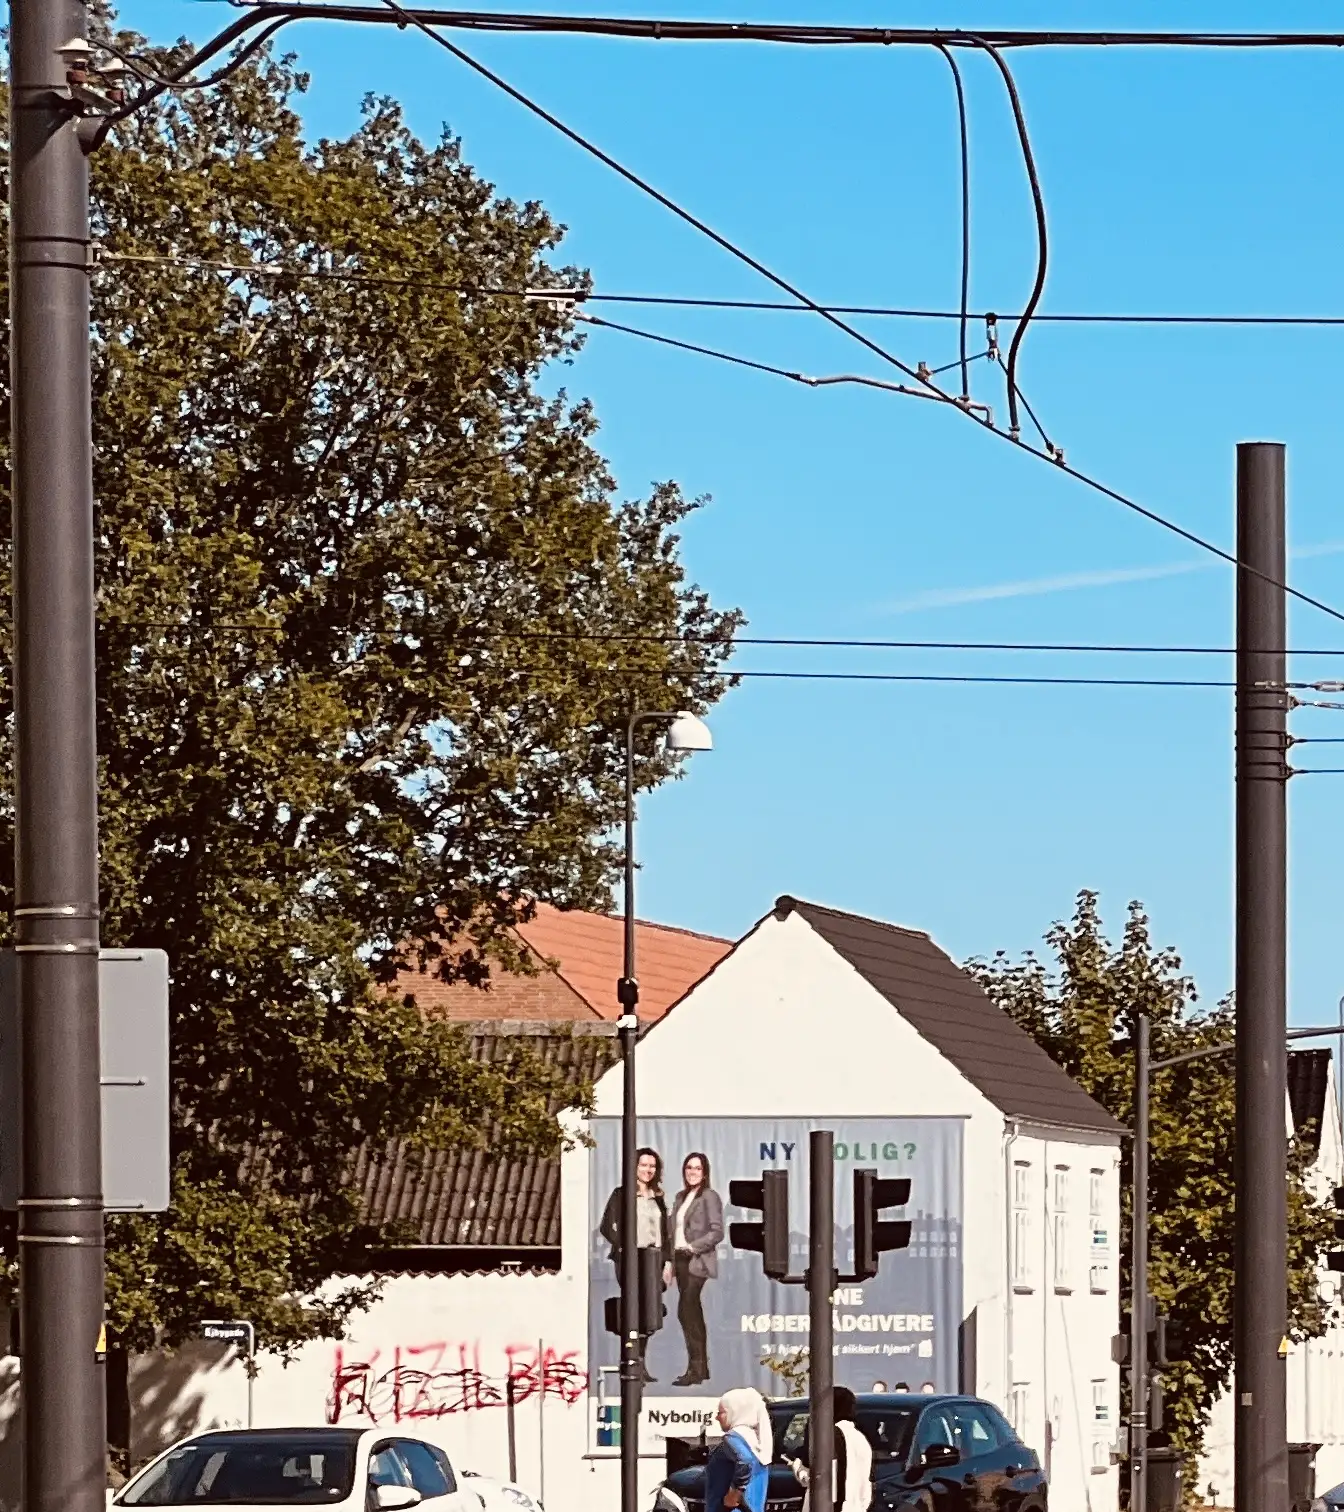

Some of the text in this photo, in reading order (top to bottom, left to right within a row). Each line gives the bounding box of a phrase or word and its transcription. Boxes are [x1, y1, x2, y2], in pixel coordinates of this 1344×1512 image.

[759, 1142, 796, 1161] NY
[741, 1310, 934, 1333] KØBERÅDGIVERE
[648, 1409, 713, 1426] Nybolig
